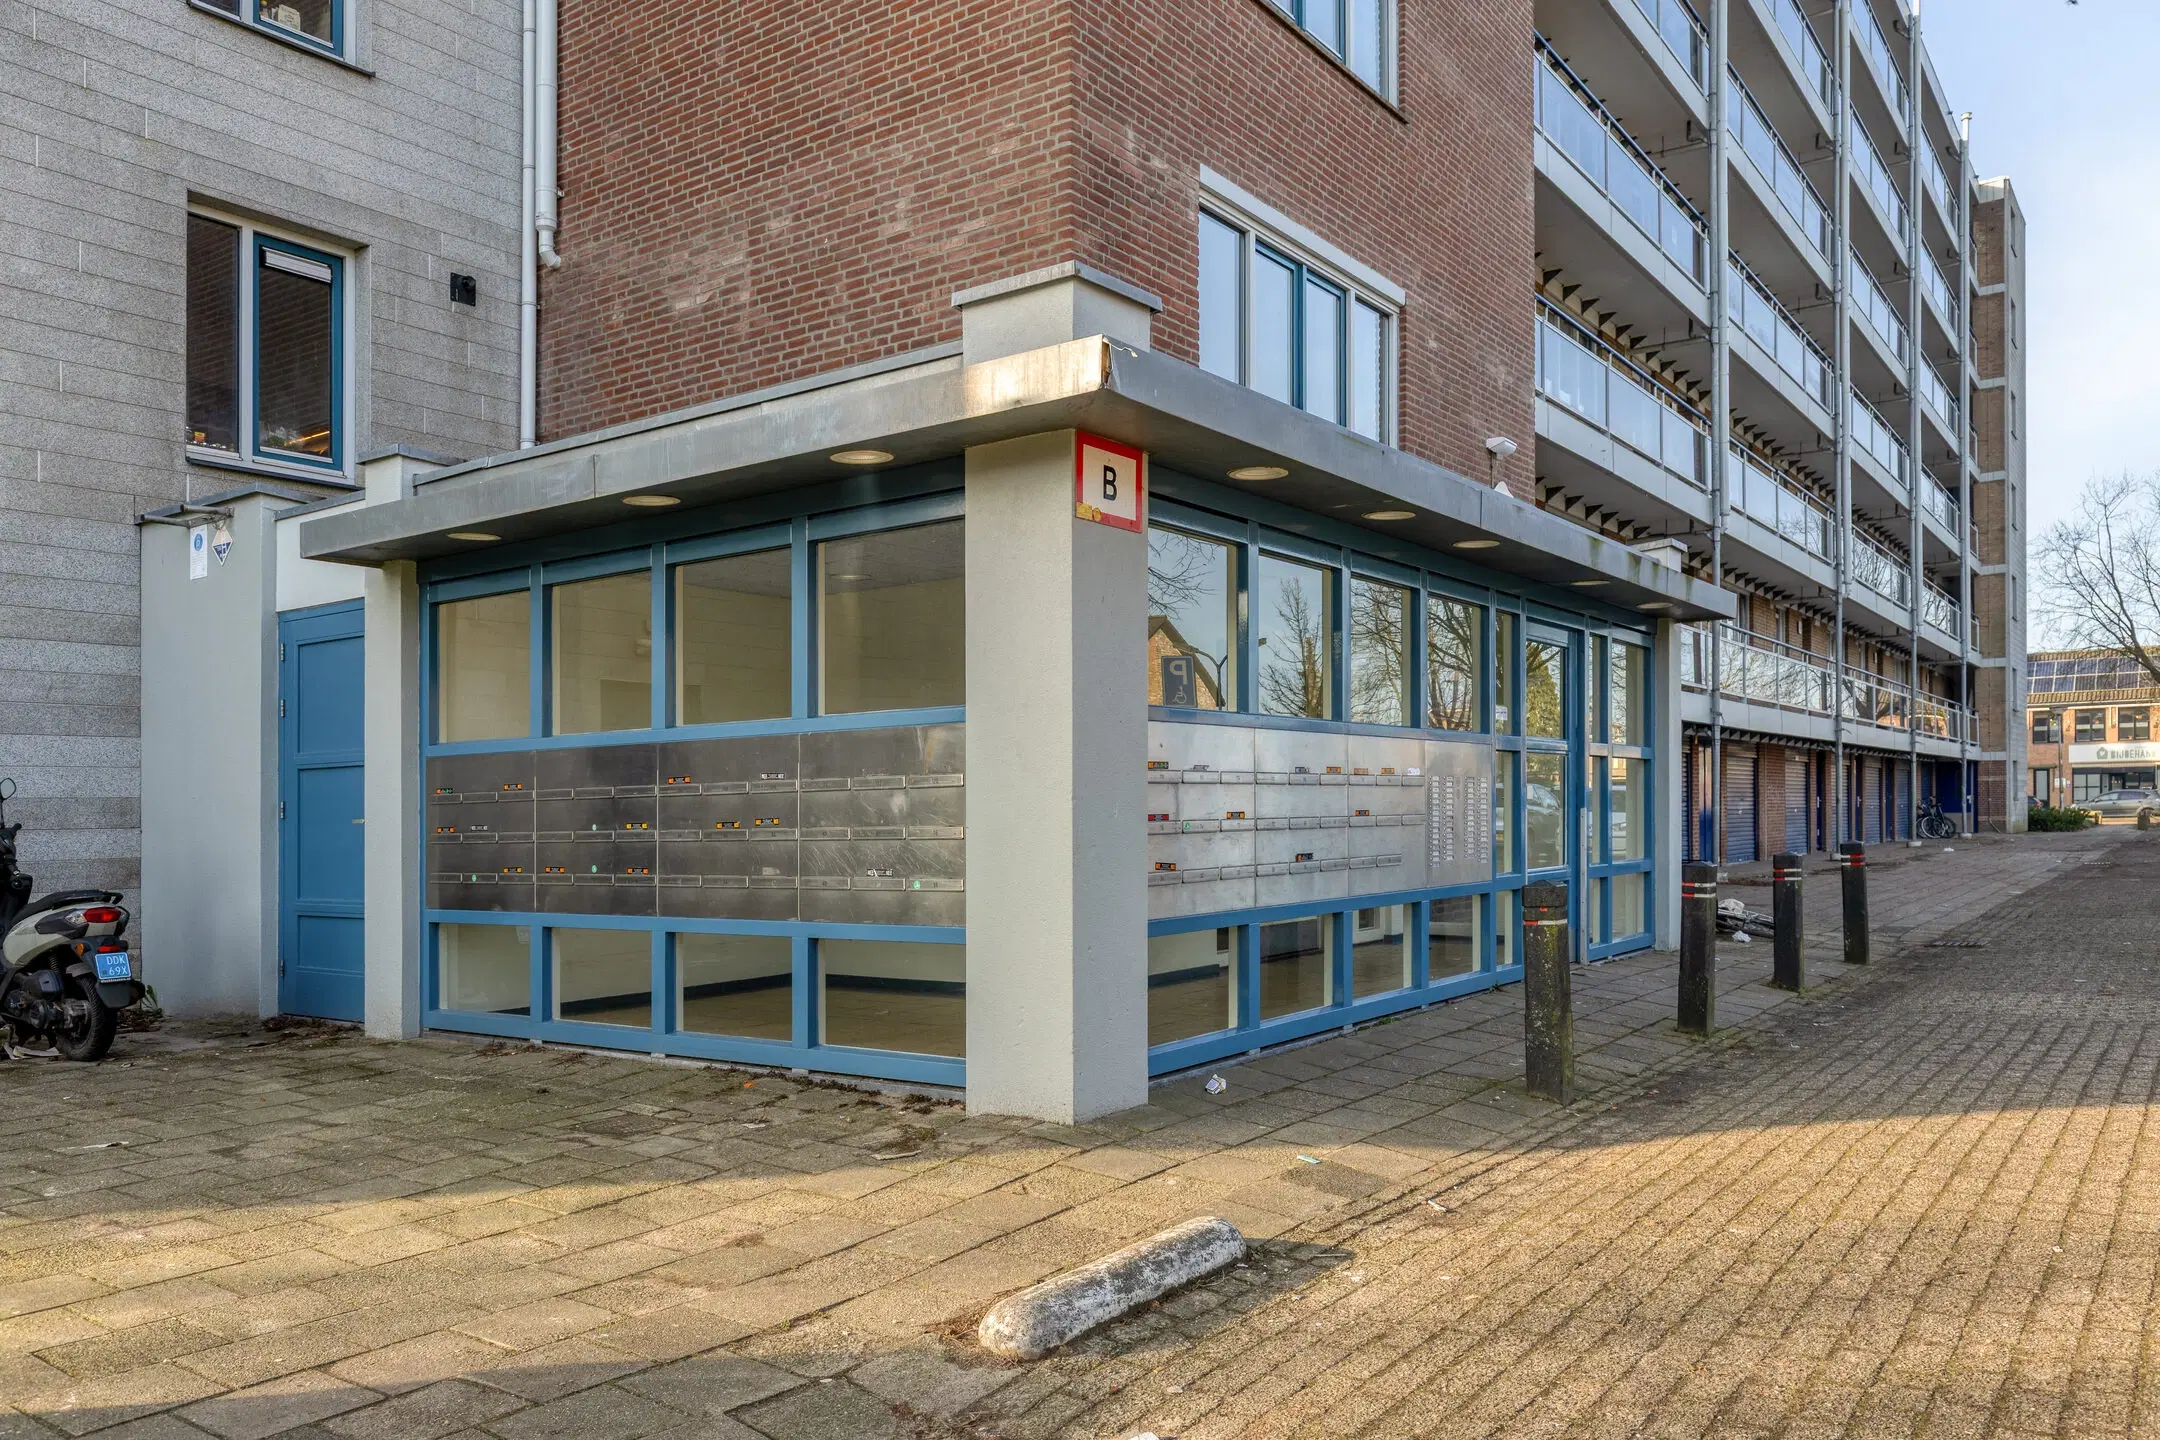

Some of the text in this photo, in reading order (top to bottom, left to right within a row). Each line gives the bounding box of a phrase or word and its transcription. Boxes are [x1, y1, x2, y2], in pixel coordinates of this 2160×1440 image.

[1103, 464, 1117, 501] B
[106, 955, 126, 965] DDK
[109, 966, 128, 976] 69X
